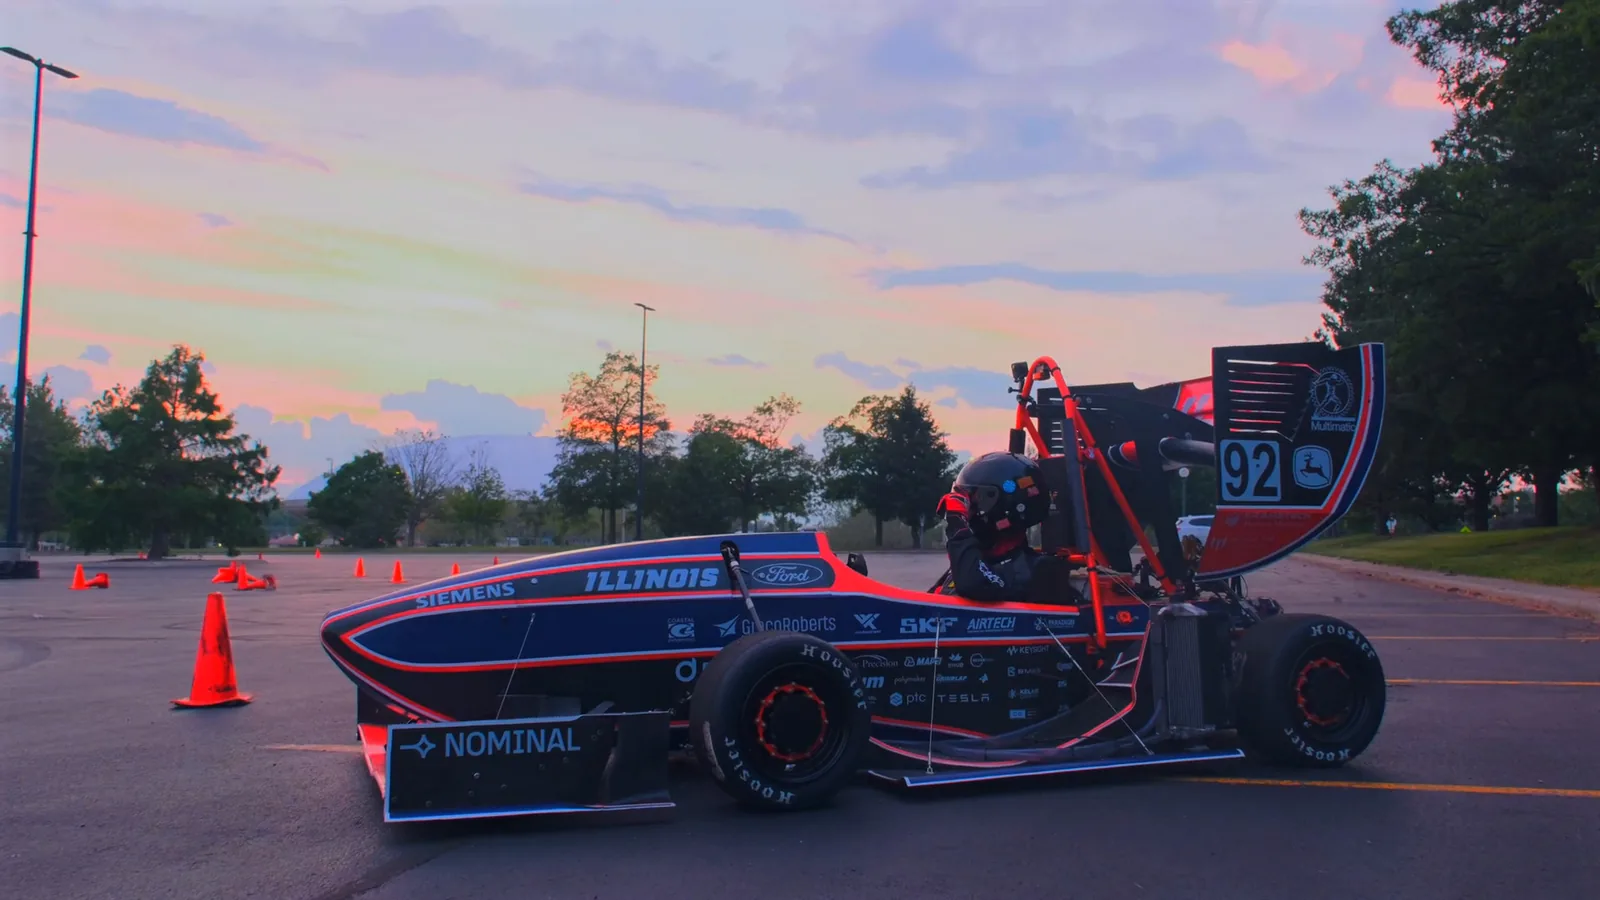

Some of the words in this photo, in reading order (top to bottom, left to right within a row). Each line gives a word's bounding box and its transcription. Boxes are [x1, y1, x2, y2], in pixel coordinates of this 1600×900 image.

[1311, 421, 1356, 432] Multimatic
[1224, 442, 1278, 497] 92
[585, 567, 720, 592] ILLINOIS
[766, 566, 809, 582] Ford
[416, 582, 515, 609] SIEMENS
[900, 617, 958, 633] SKF
[967, 616, 1016, 630] AIRTECH
[862, 660, 899, 668] Precision
[916, 656, 942, 666] MAPEI
[907, 692, 926, 706] ptc
[937, 694, 990, 703] TESLA
[445, 728, 581, 757] NOMINAL
